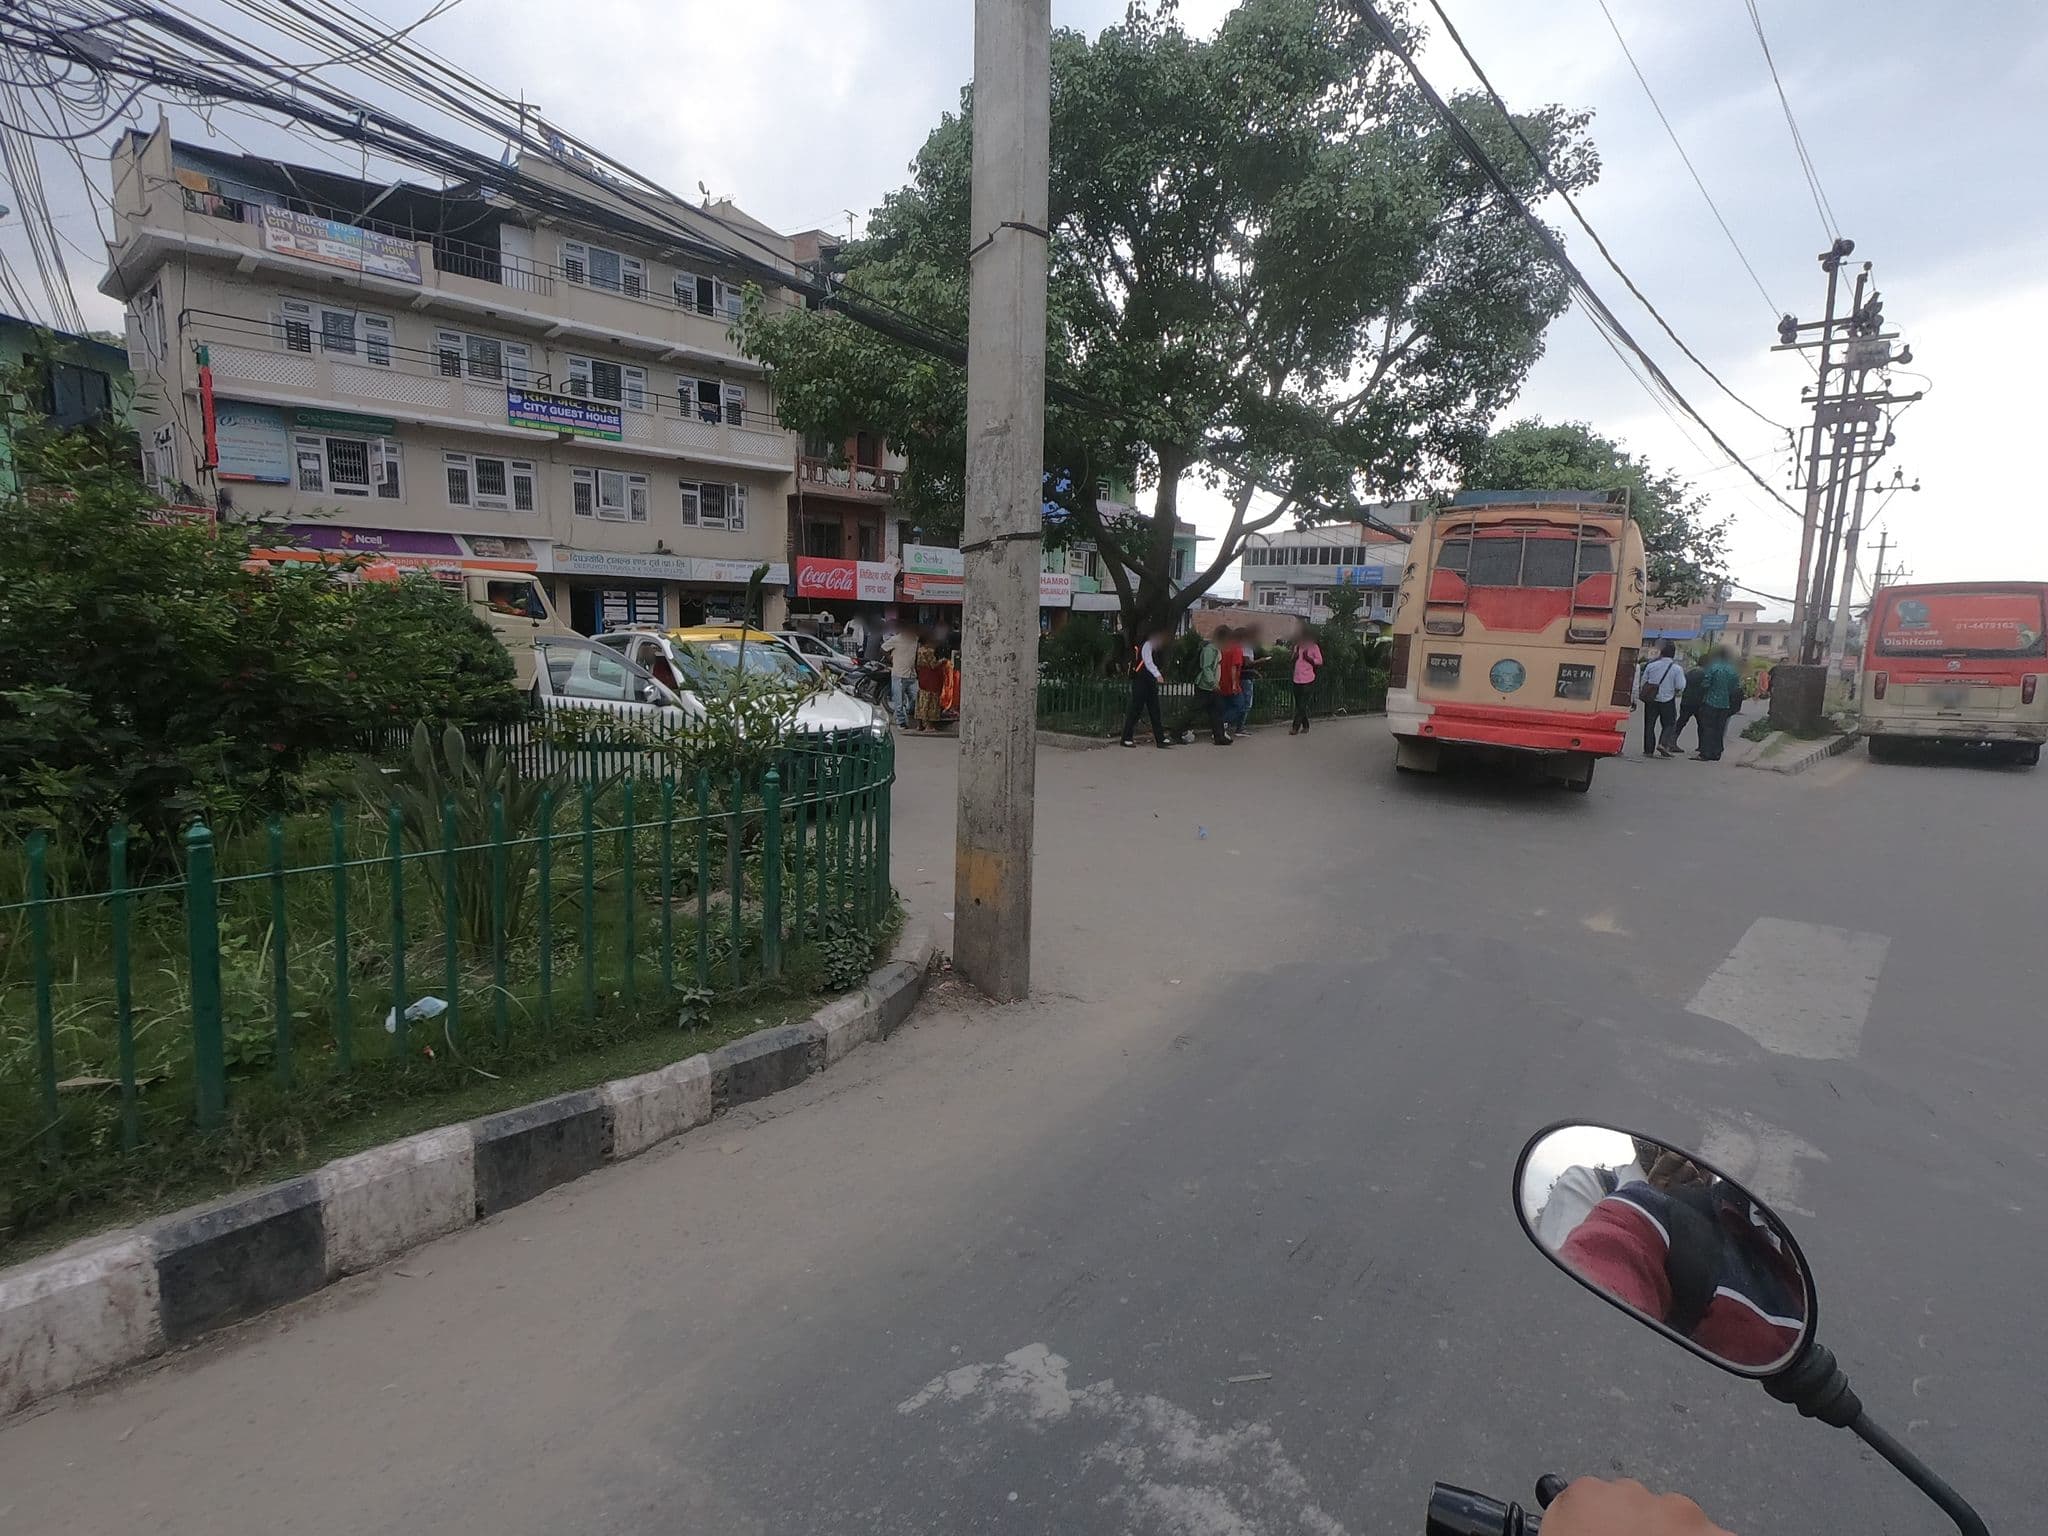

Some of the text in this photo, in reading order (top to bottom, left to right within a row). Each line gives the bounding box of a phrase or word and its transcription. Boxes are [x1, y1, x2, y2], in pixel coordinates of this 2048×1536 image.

[268, 217, 293, 231] CITY
[296, 224, 329, 239] HOTEL
[381, 244, 415, 259] HOUSE
[523, 402, 547, 413] CITY
[549, 406, 584, 418] GUEST
[586, 412, 620, 425] HOUSE
[355, 534, 383, 545] Ncell
[800, 565, 856, 592] Coca-Cola
[1040, 576, 1069, 586] HAMRO
[1883, 637, 1944, 647] DishHome
